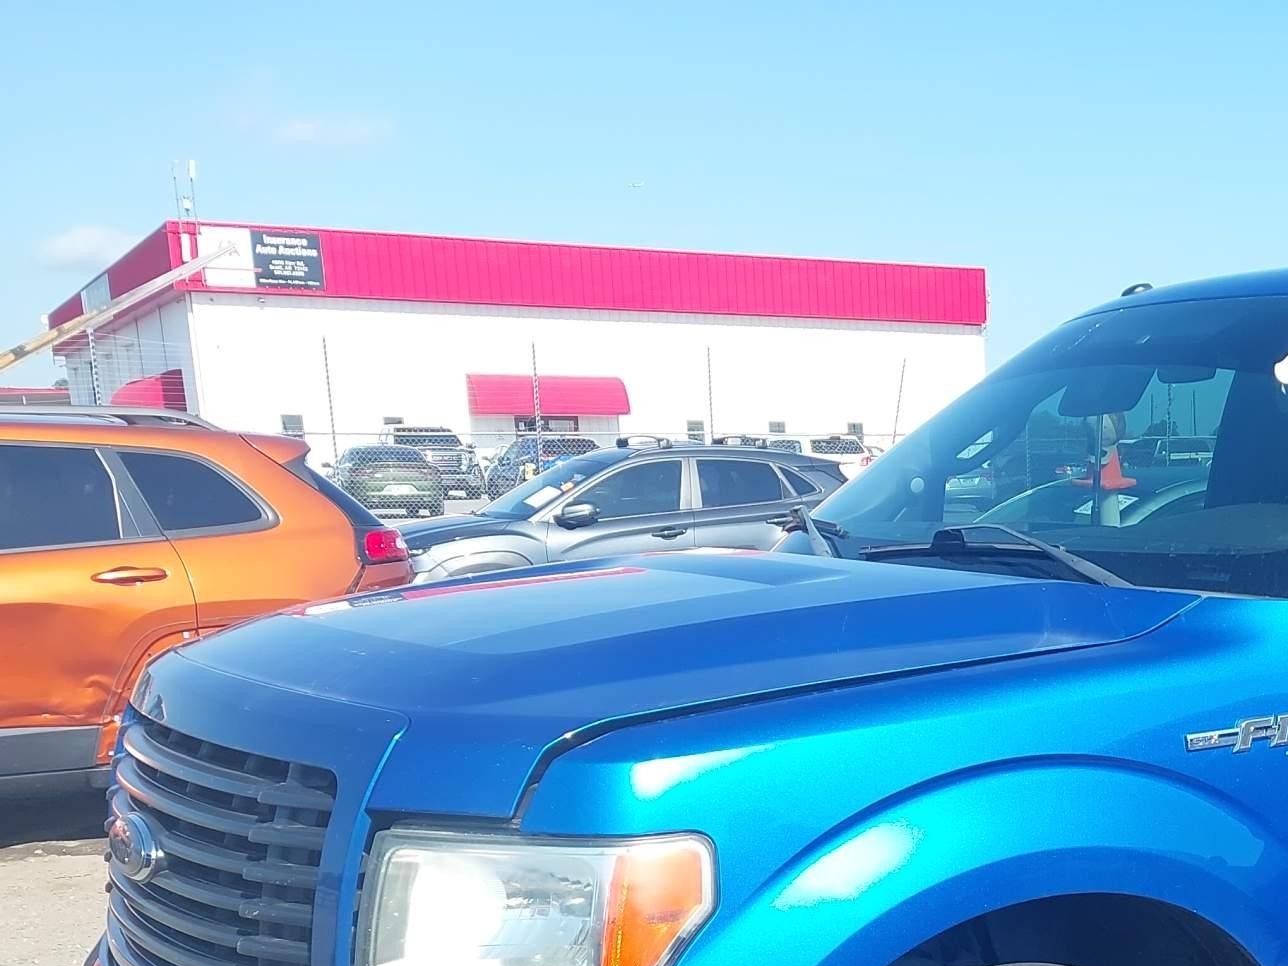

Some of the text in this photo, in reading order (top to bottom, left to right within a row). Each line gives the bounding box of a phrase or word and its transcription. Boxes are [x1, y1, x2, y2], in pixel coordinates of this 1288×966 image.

[262, 234, 308, 246] Insurance
[255, 244, 318, 256] Auto Auctions
